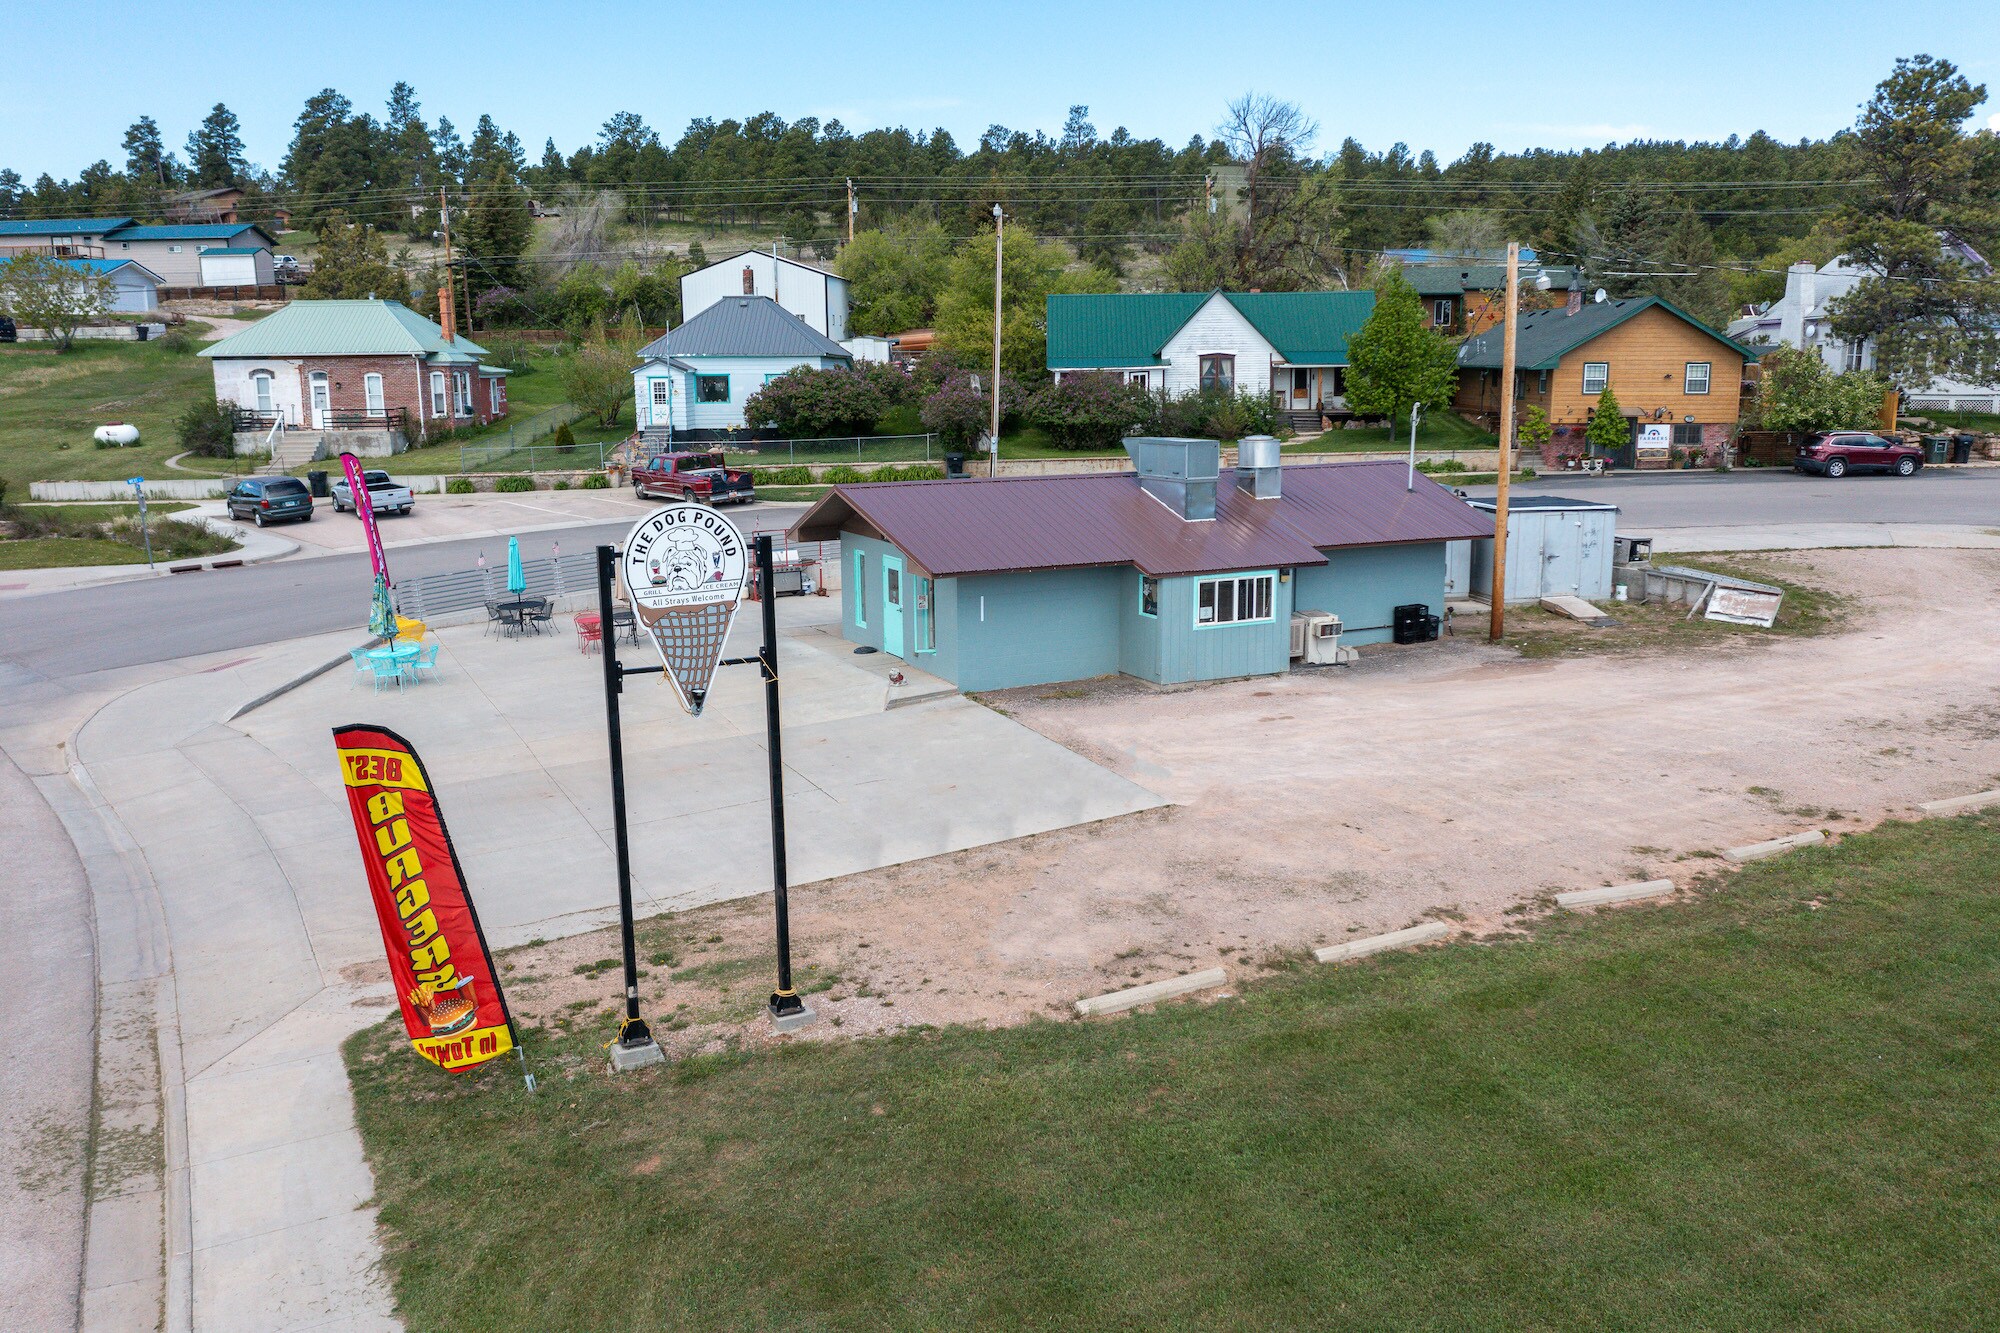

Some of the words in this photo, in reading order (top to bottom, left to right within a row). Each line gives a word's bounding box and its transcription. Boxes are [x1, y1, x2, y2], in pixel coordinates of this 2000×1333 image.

[632, 532, 654, 565] THE
[652, 510, 686, 533] DOG
[693, 512, 737, 557] POUND
[715, 581, 739, 589] CREAM
[652, 599, 663, 607] All
[665, 597, 690, 607] Strays
[691, 593, 725, 602] Welcome
